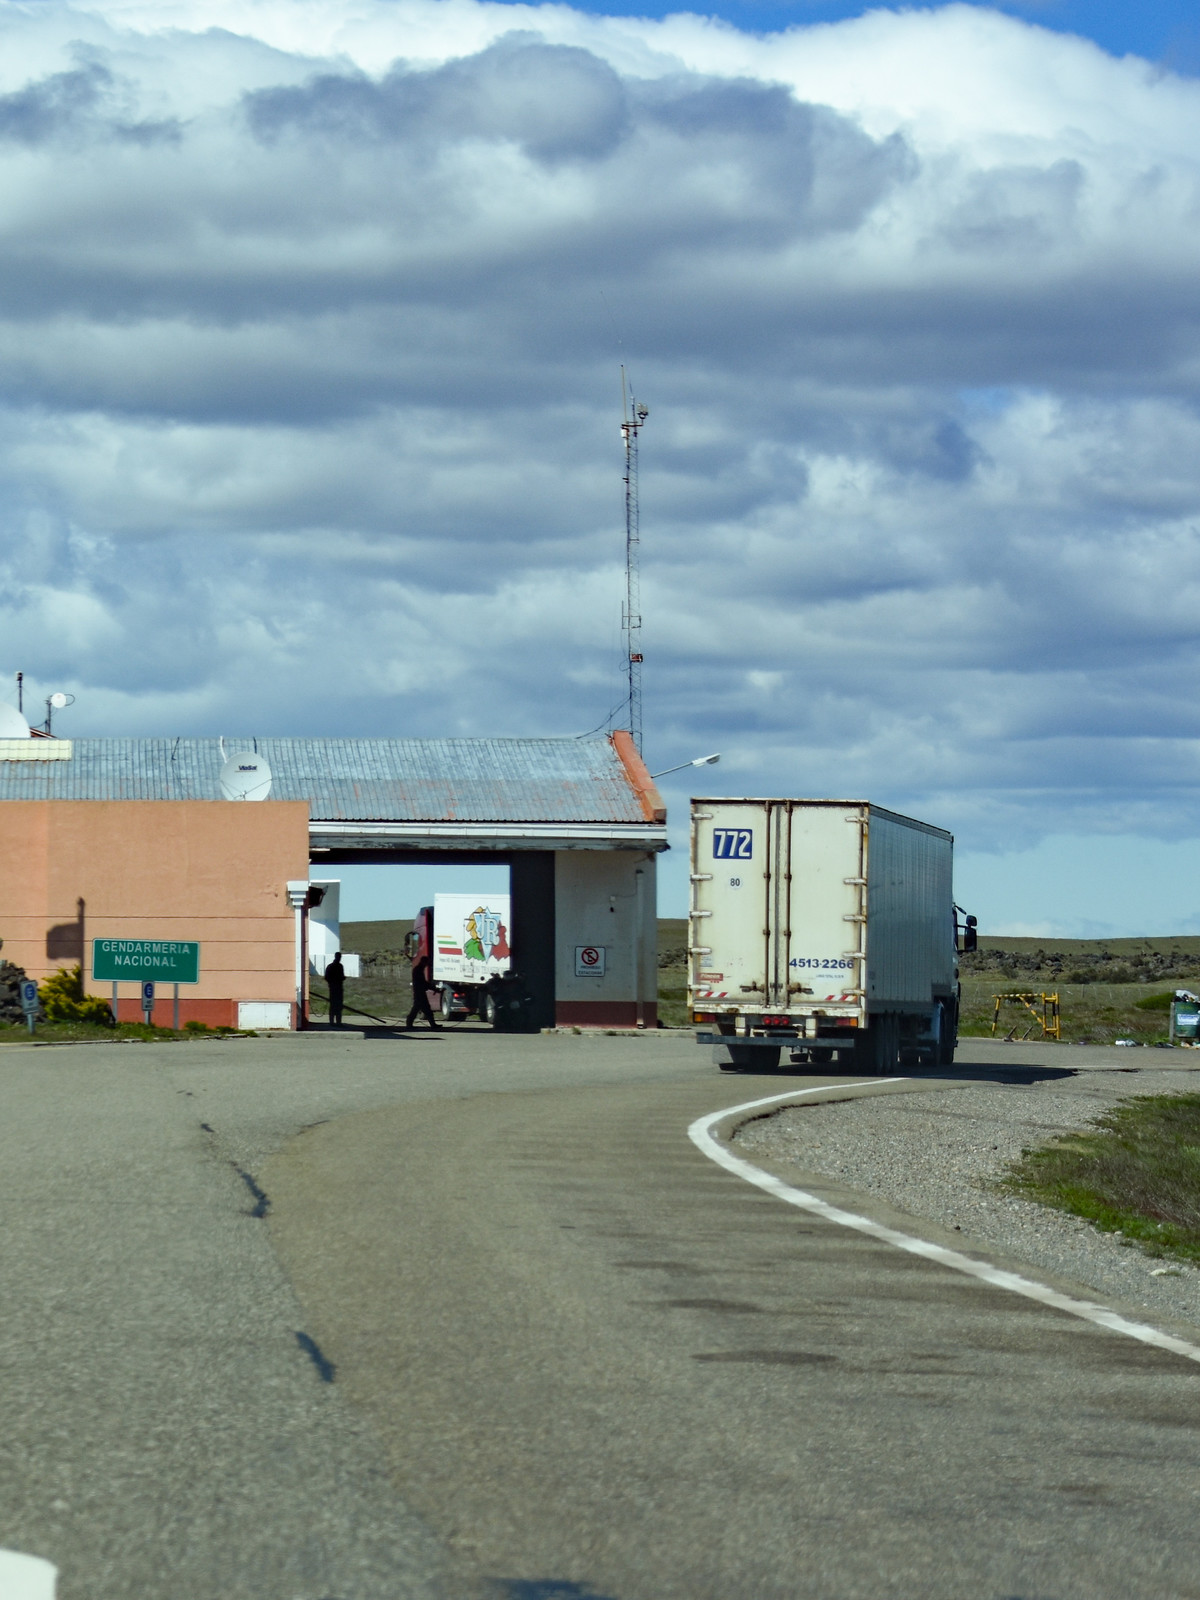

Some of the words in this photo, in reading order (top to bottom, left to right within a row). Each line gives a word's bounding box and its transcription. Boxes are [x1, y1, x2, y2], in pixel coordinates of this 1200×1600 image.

[714, 830, 751, 857] 772
[730, 878, 740, 887] 80
[101, 941, 191, 954] GENDARMERIA
[114, 955, 177, 967] NACIONAL
